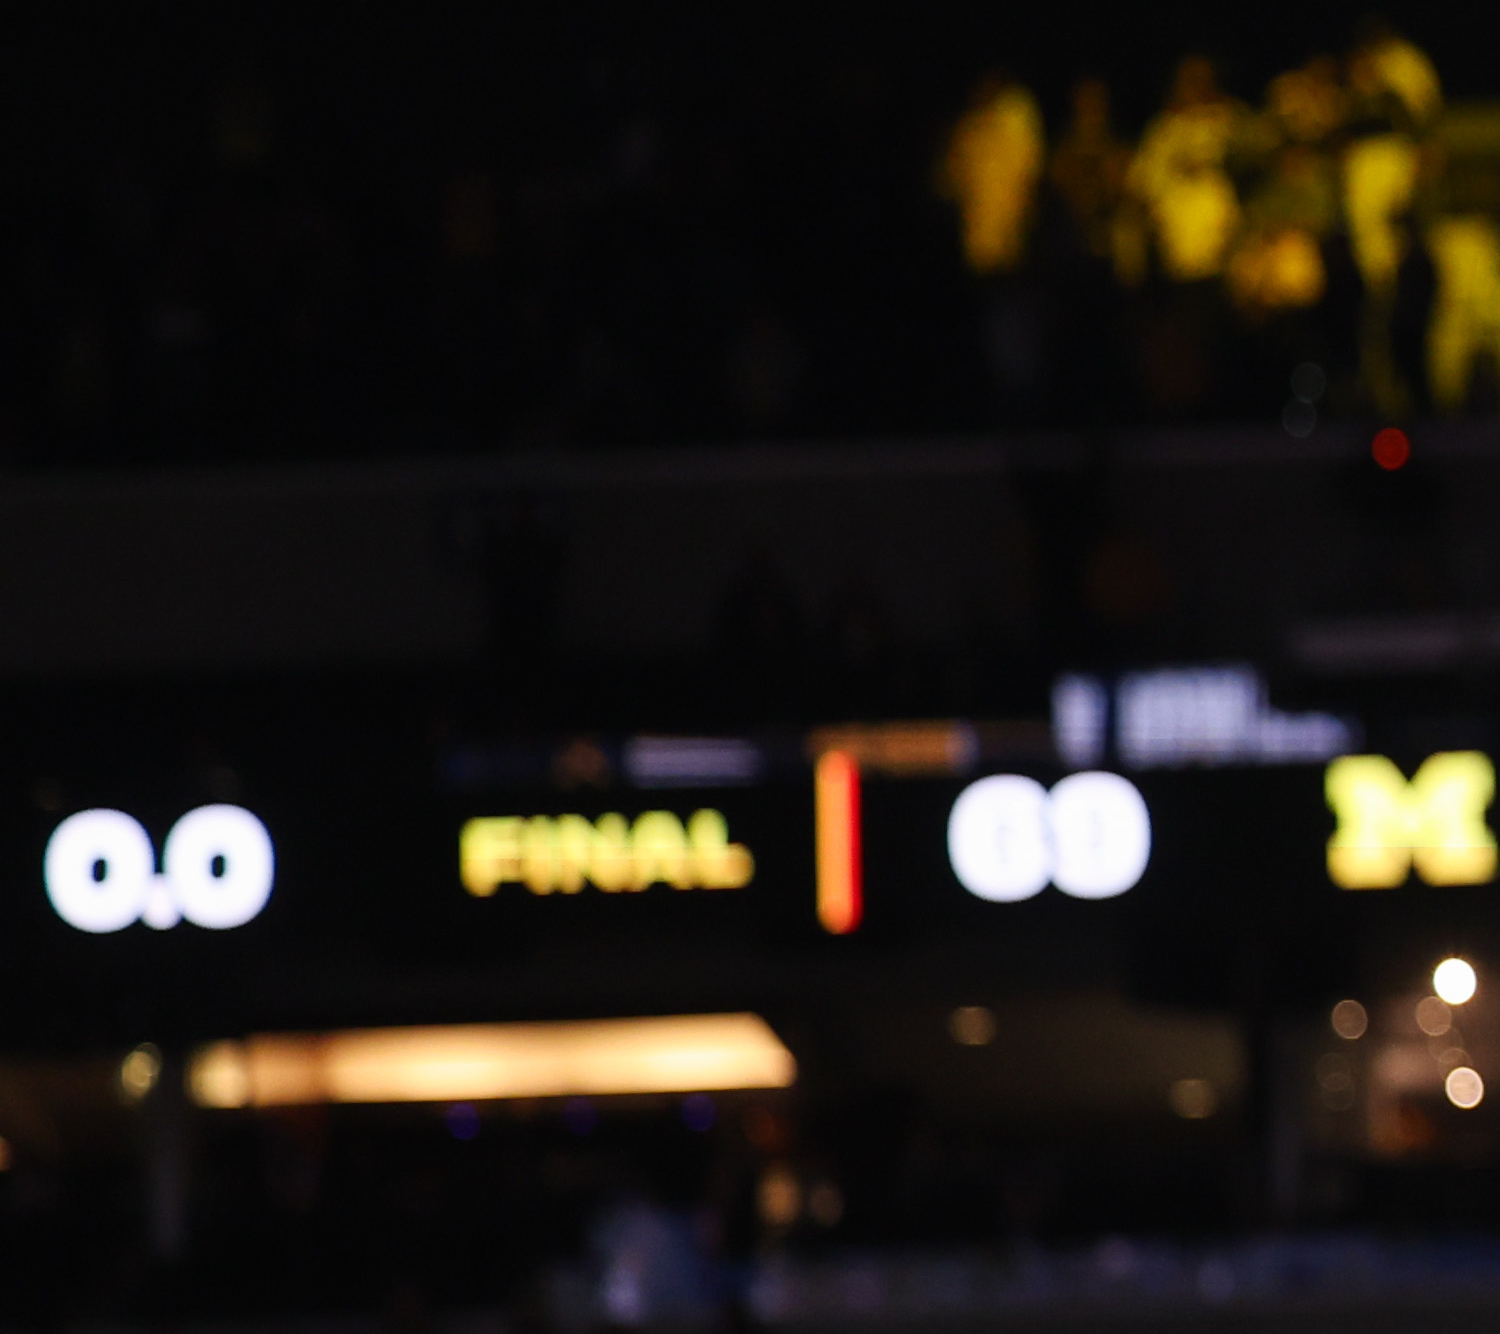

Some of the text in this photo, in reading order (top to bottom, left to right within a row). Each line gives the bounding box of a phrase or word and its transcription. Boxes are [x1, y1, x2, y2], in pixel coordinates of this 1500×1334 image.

[43, 803, 275, 934] 0.0
[459, 808, 756, 898] FINAL
[1323, 749, 1500, 891] M
